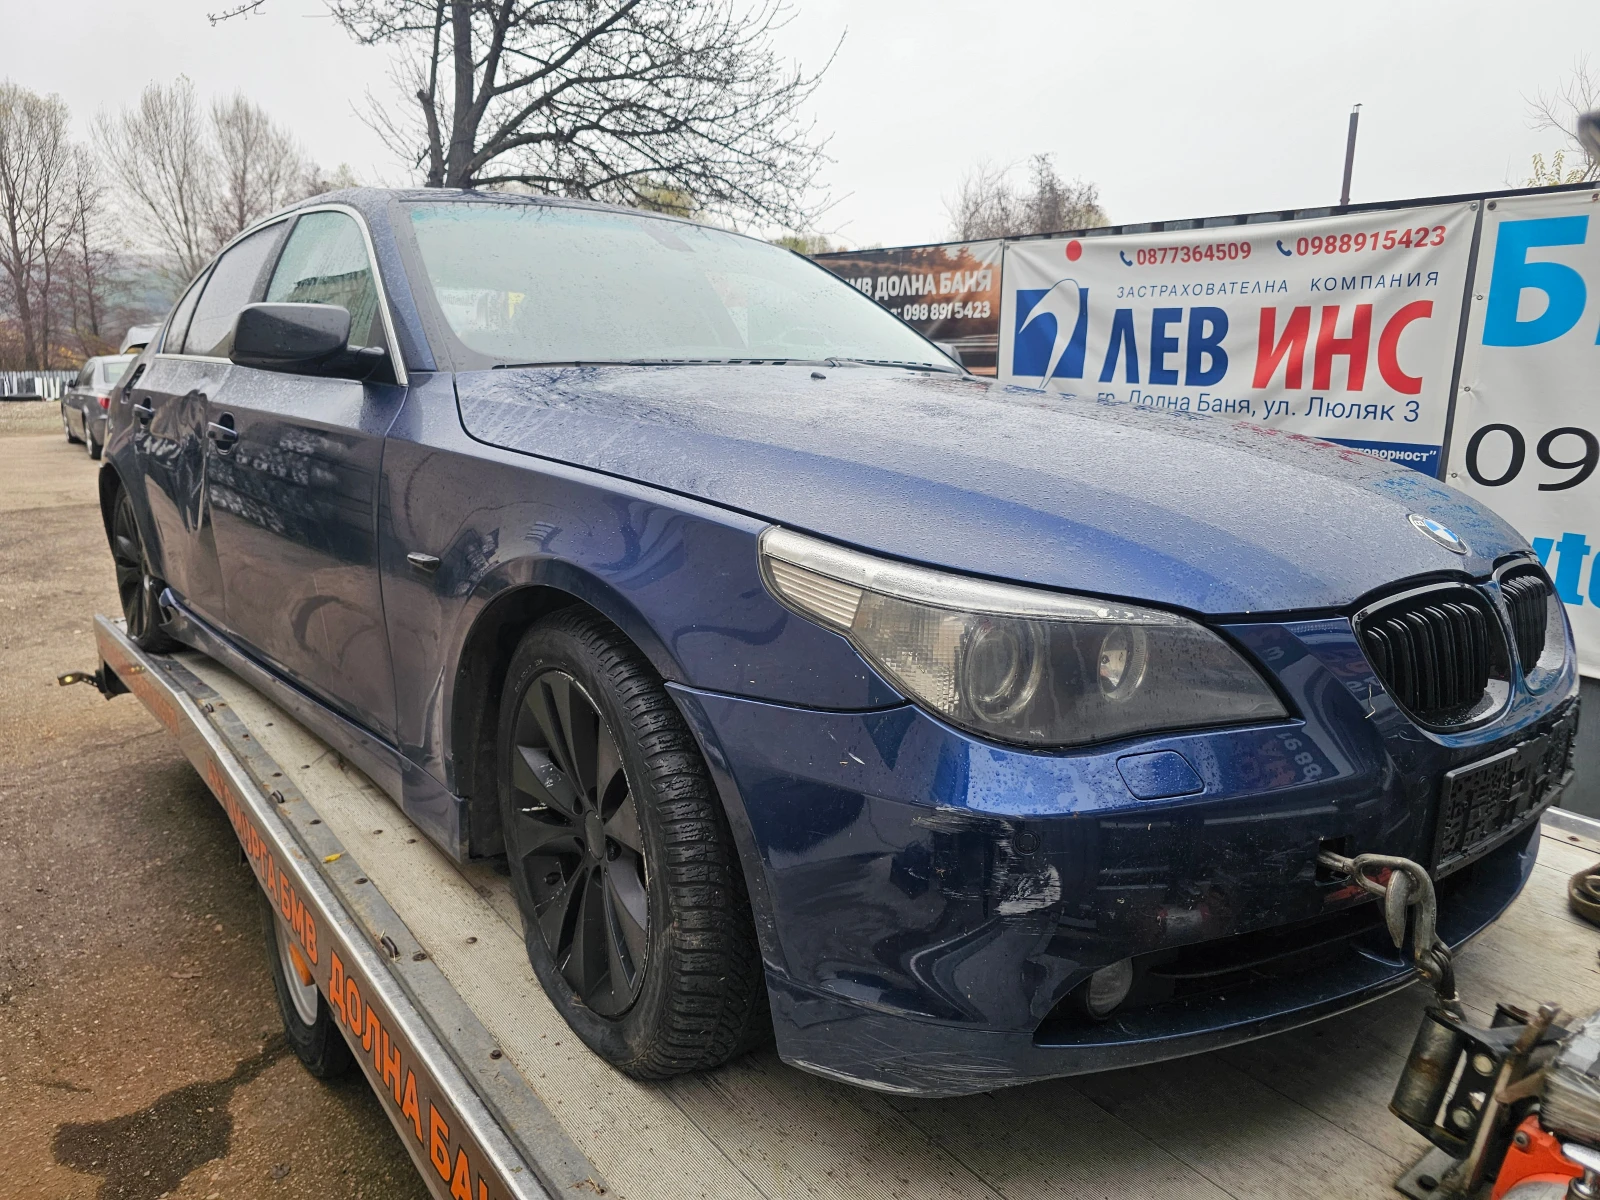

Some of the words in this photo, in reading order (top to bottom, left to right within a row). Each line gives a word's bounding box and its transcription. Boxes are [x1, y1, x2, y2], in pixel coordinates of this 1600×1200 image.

[1136, 241, 1252, 266] 0877364509
[1296, 225, 1447, 256] 0988915423
[874, 273, 937, 301] ДОЛНА
[939, 269, 992, 294] БАНЯ
[1116, 279, 1288, 298] ЗАСТРАХОВАТЕЛНА
[1310, 271, 1439, 291] КОМПАНИЯ
[1482, 215, 1600, 347] Б
[1098, 306, 1229, 387] ЛЕВ
[1252, 300, 1434, 395] ИНС
[1197, 393, 1256, 418] Баня,
[1263, 400, 1296, 420] ул.
[1304, 397, 1395, 422] Люляк
[1403, 400, 1420, 422] 3
[279, 867, 319, 966] БМВ
[328, 948, 425, 1148] ДОЛНА
[430, 1098, 498, 1200] БА
